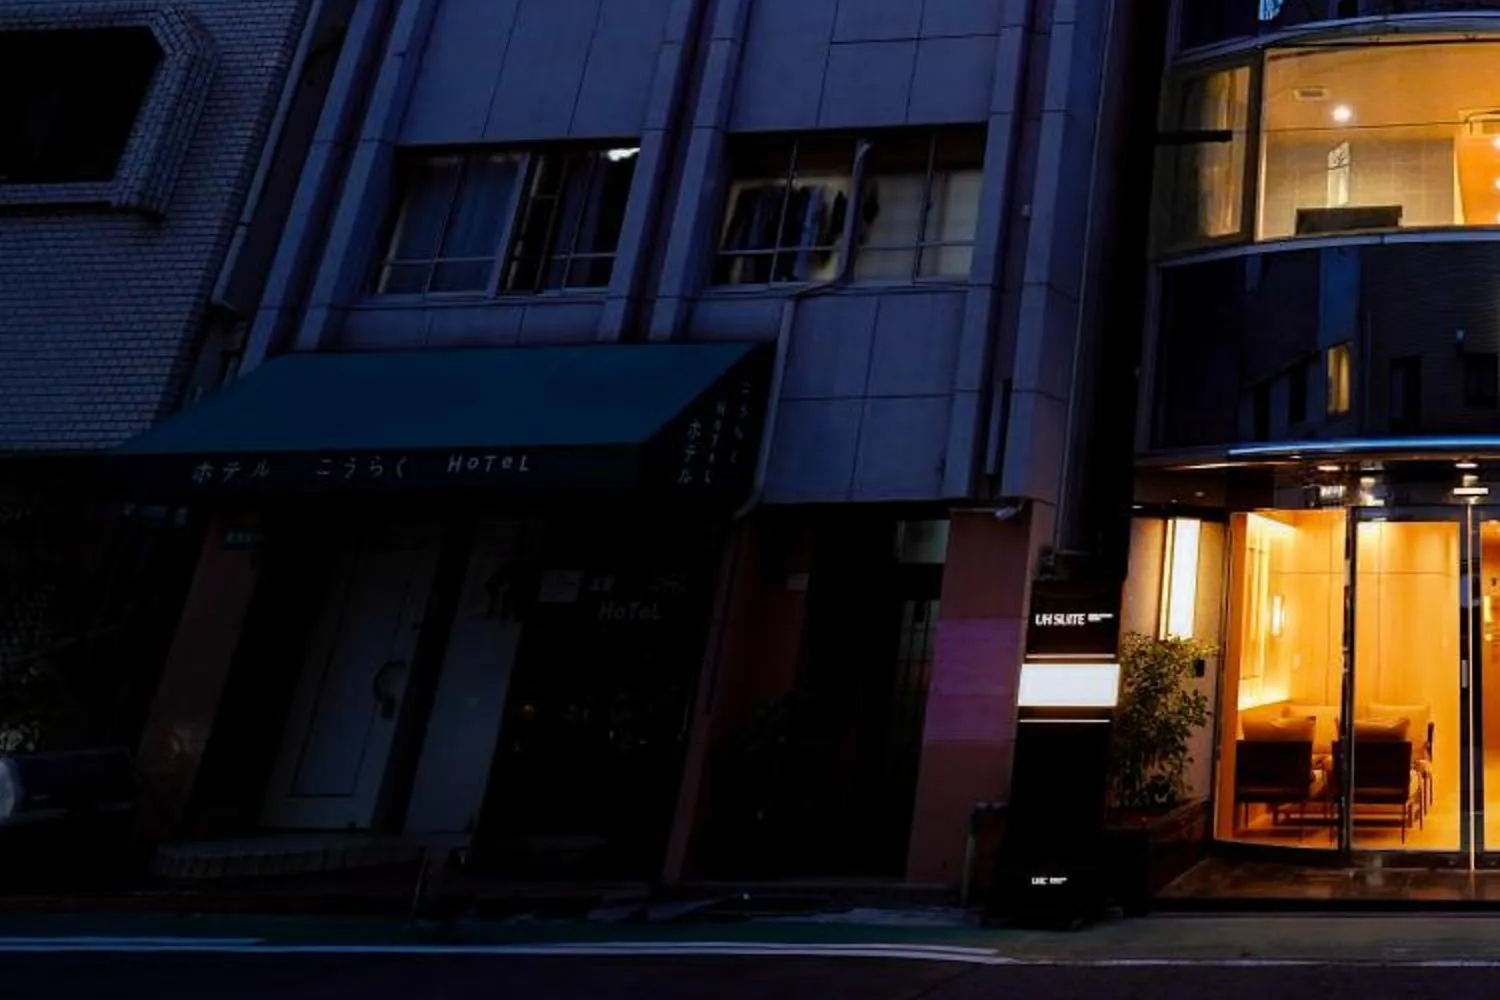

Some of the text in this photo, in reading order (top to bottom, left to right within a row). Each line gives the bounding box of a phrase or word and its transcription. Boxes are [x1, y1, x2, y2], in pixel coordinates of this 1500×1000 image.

[191, 457, 271, 484] ホテル
[315, 454, 408, 480] こうらく
